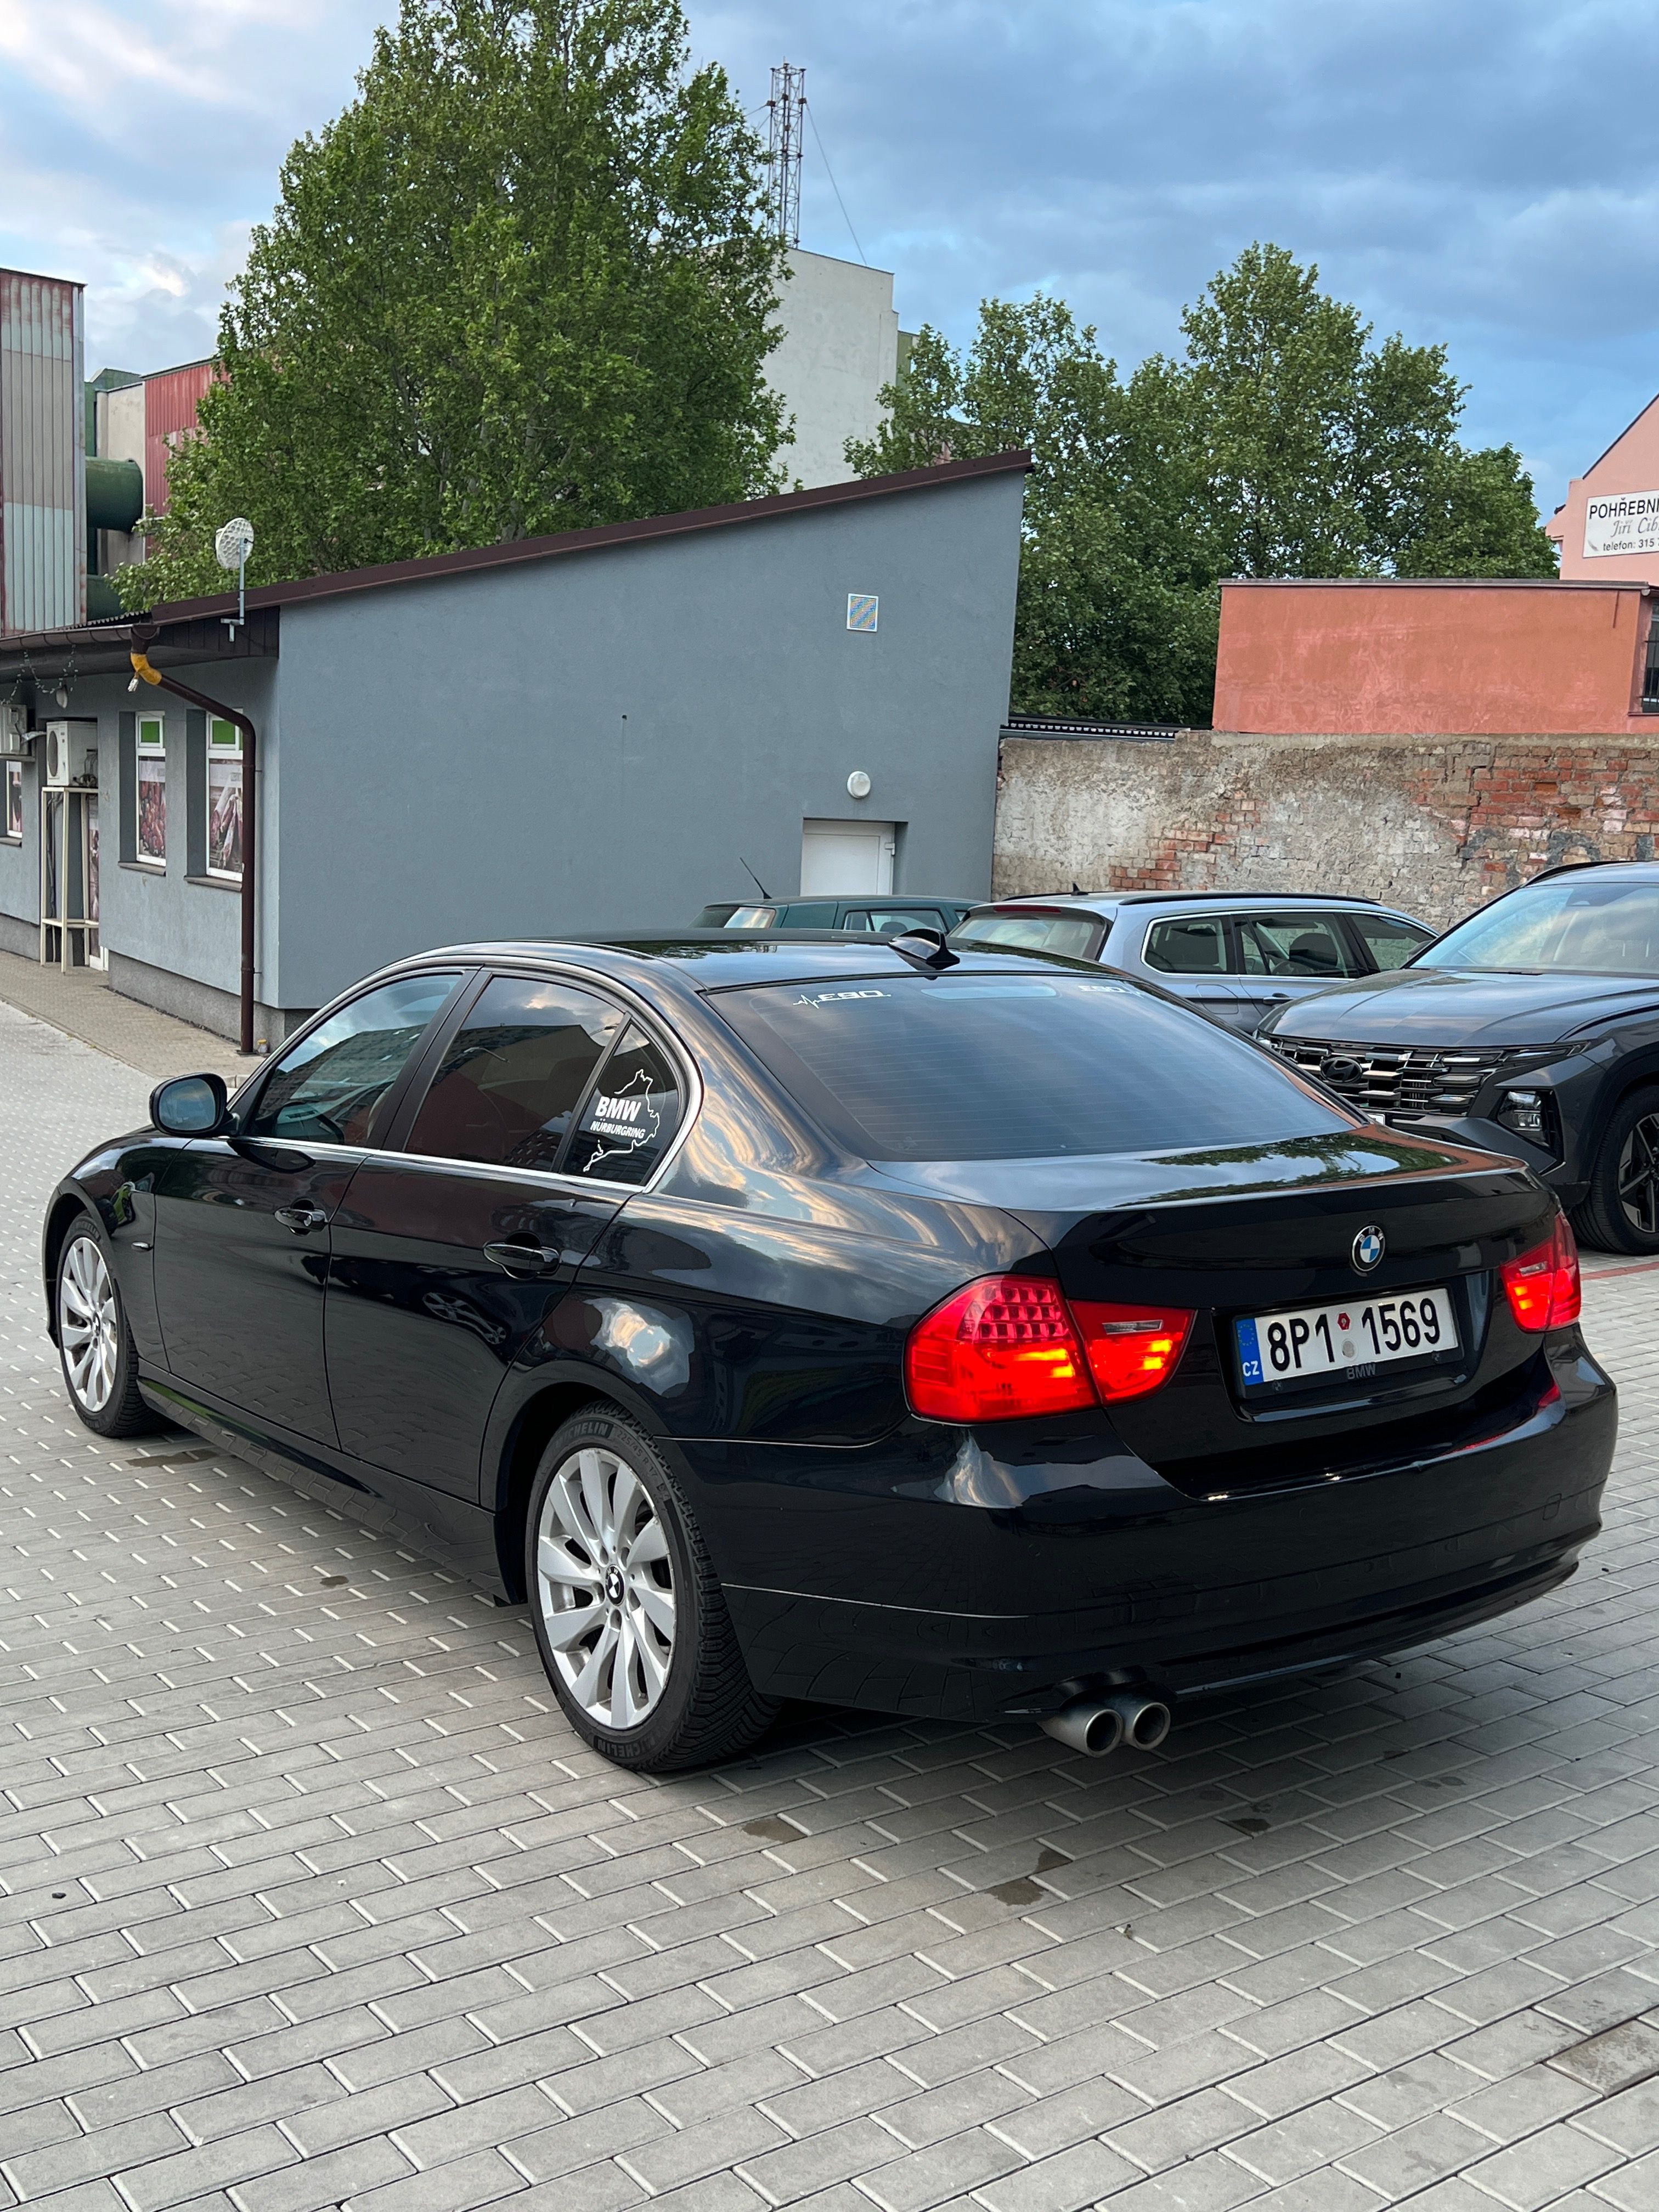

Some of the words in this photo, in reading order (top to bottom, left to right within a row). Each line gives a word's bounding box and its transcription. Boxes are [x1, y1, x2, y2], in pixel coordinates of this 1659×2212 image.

[1610, 520, 1633, 538] Jiří
[1638, 516, 1659, 533] Cib
[1603, 541, 1636, 551] telefon:
[1638, 538, 1655, 548] 315
[818, 990, 884, 1001] E90
[595, 1096, 642, 1122] BMW
[590, 1118, 646, 1139] NÜRBURGRING
[1358, 1227, 1384, 1242] BMW
[1267, 1313, 1335, 1372] 8P1
[1361, 1297, 1441, 1355] 1569
[1243, 1360, 1260, 1377] CZ
[1347, 1363, 1376, 1380] BMW
[616, 1428, 644, 1457] 225/45
[648, 1466, 658, 1478] 17
